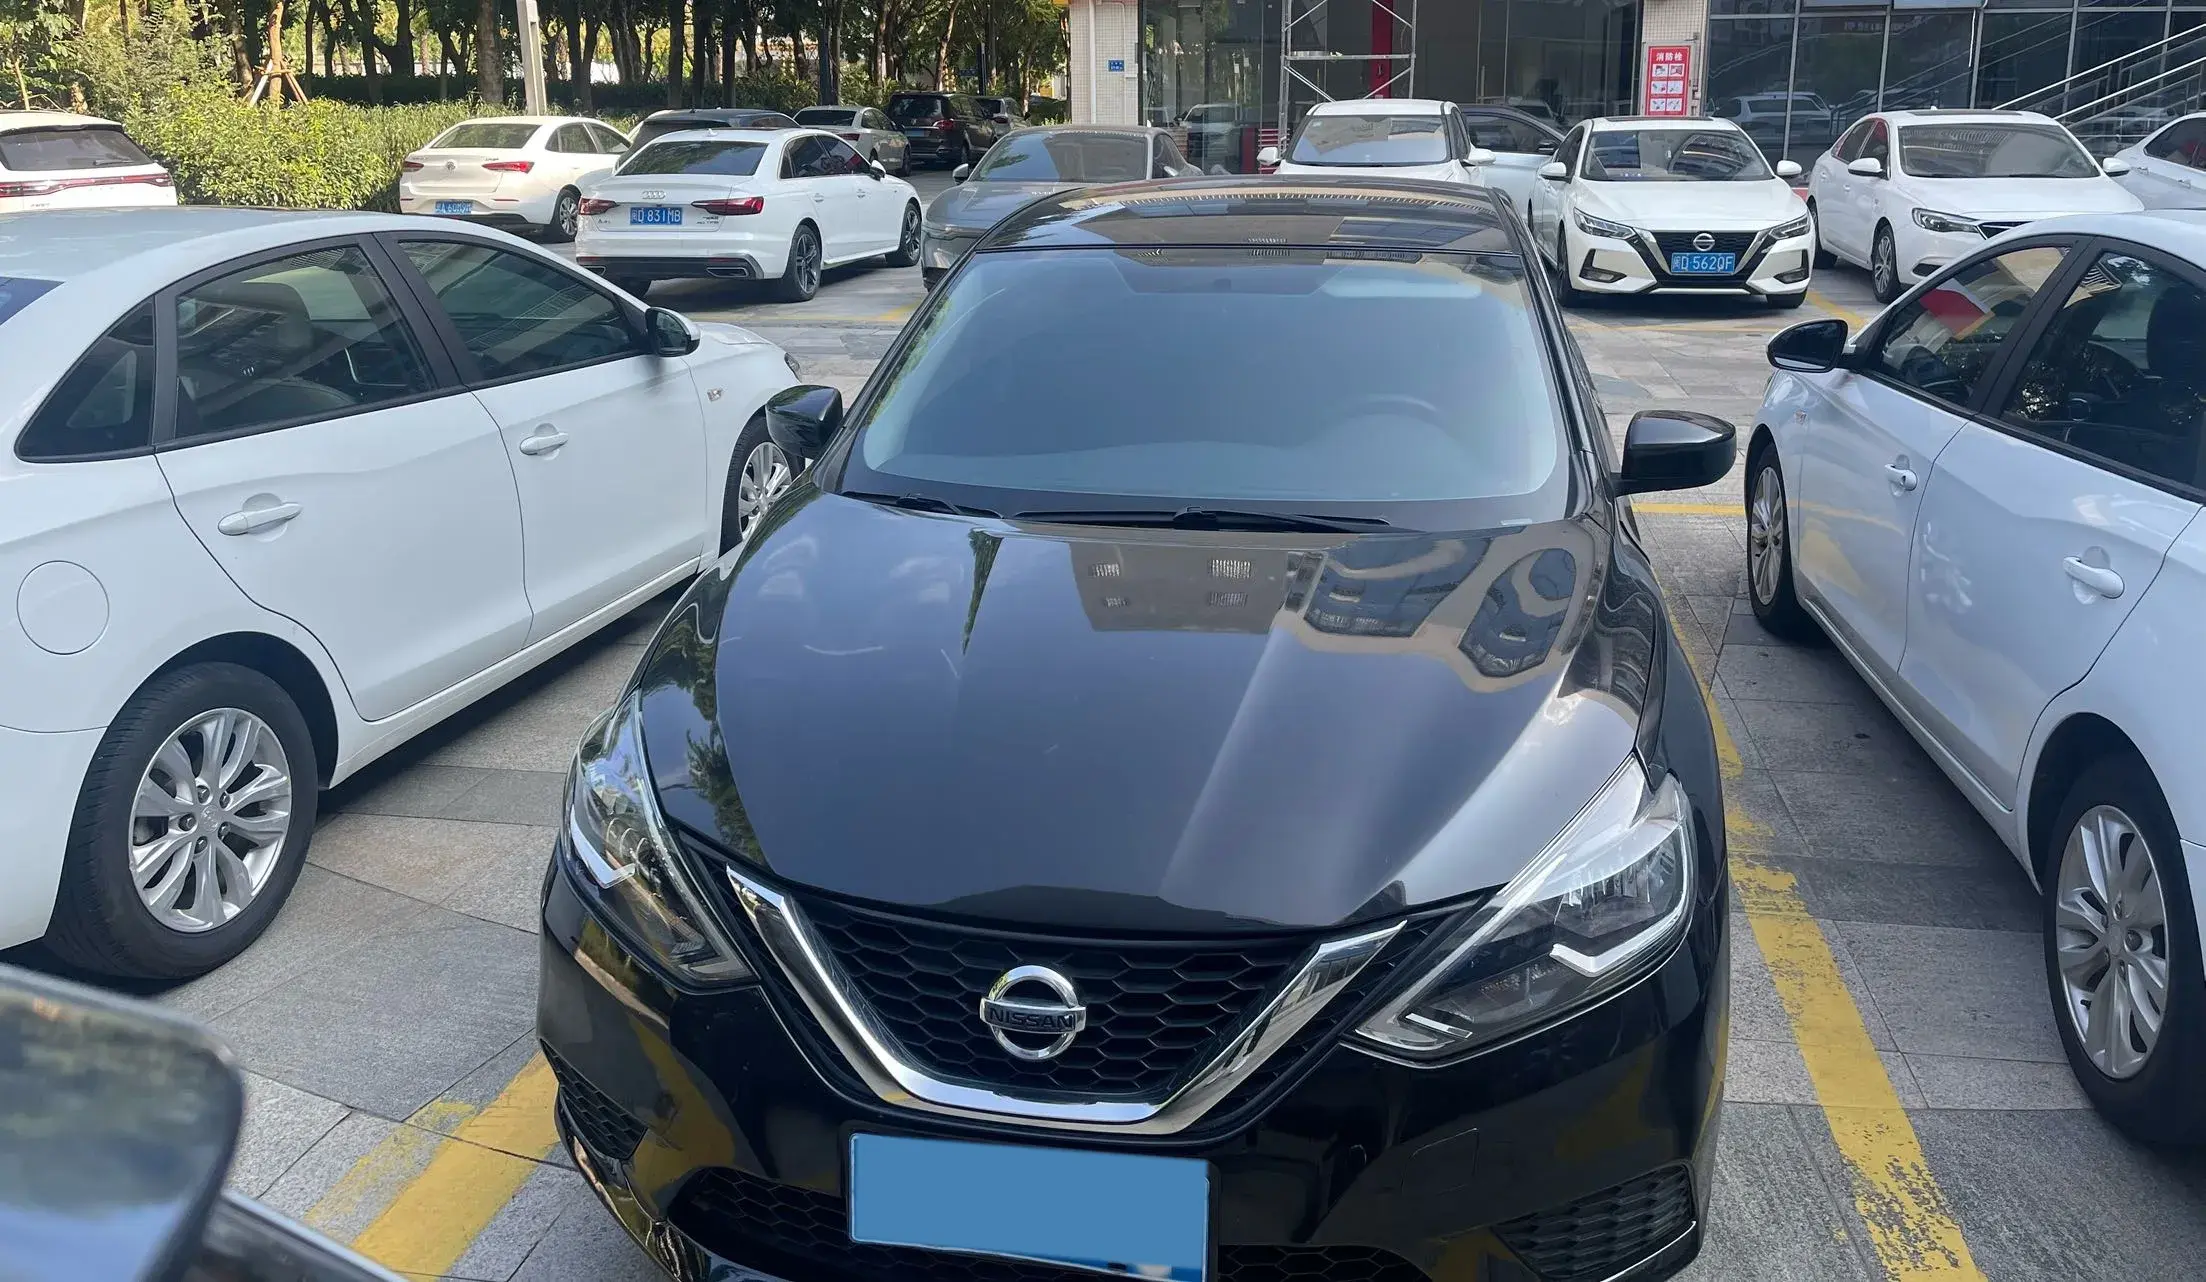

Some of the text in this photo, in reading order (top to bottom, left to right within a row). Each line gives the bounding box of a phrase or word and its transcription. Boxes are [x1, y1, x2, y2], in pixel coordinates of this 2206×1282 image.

[1656, 52, 1683, 61] 消防栓
[989, 1007, 1076, 1029] NISSAN
